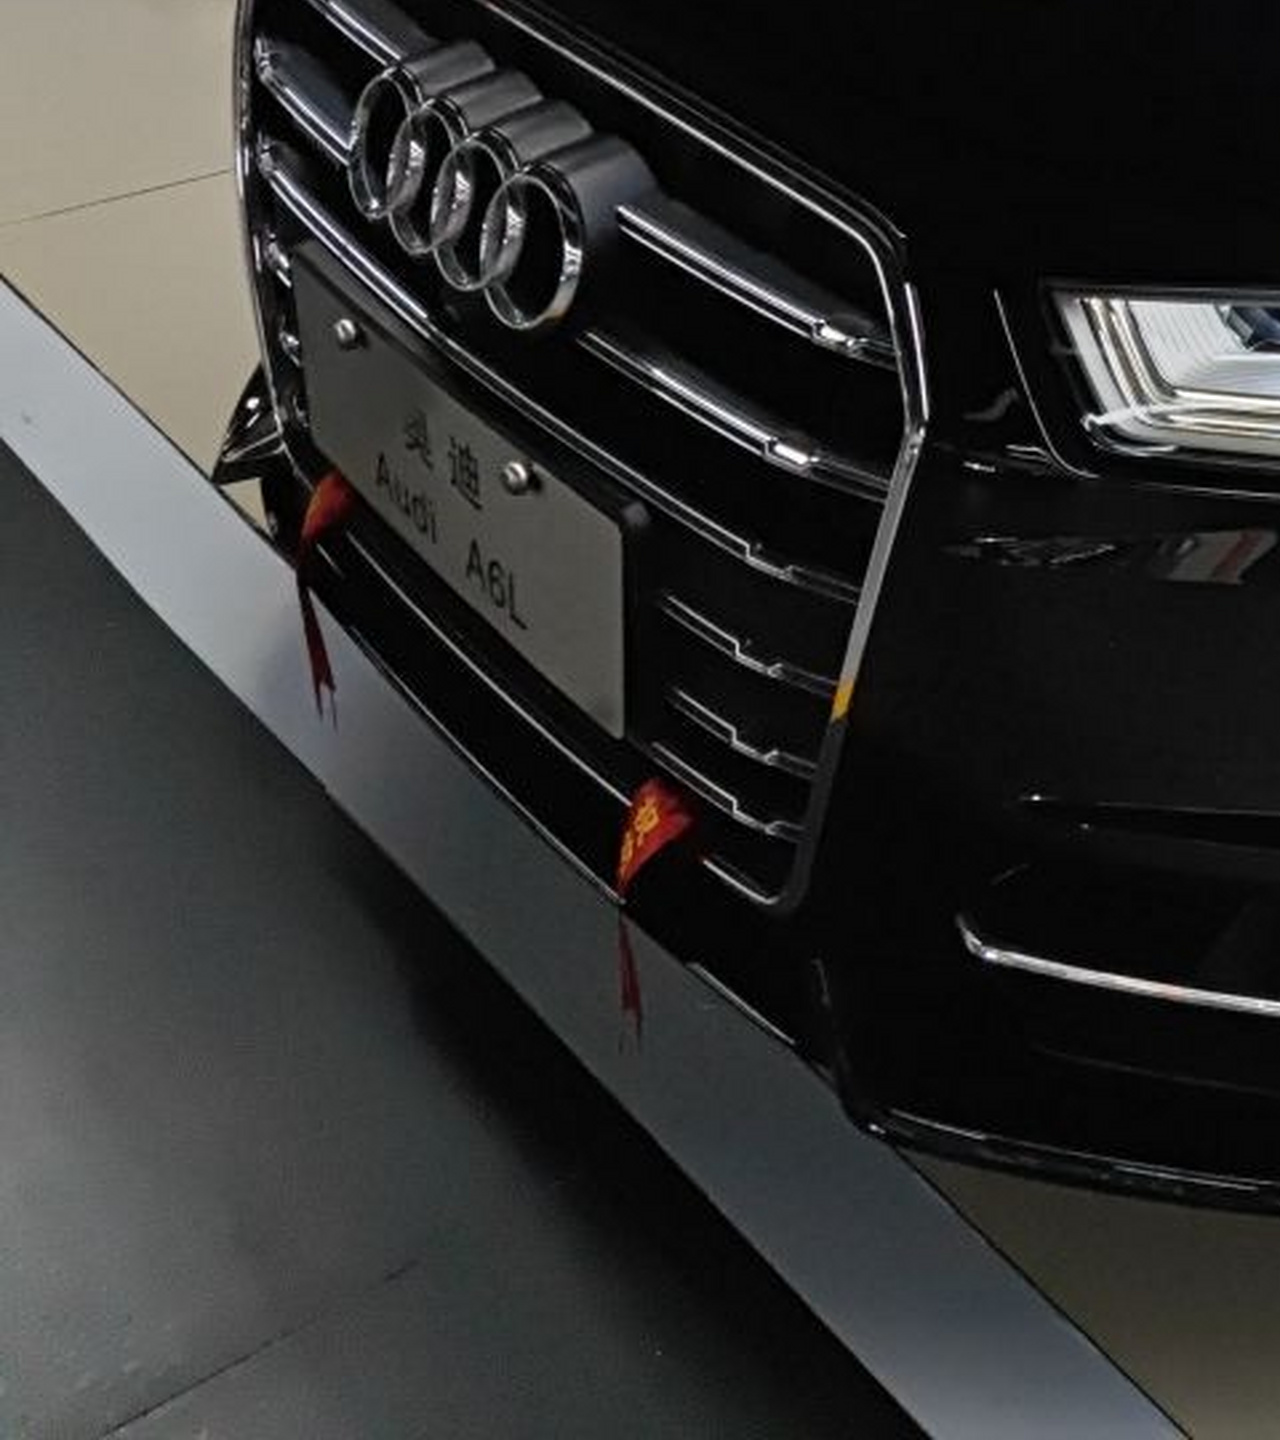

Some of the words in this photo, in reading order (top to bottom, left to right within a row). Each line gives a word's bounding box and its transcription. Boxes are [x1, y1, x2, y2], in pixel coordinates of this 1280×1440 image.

[404, 410, 483, 510] 奥迪
[376, 451, 438, 545] Audi
[466, 538, 528, 631] A6L
